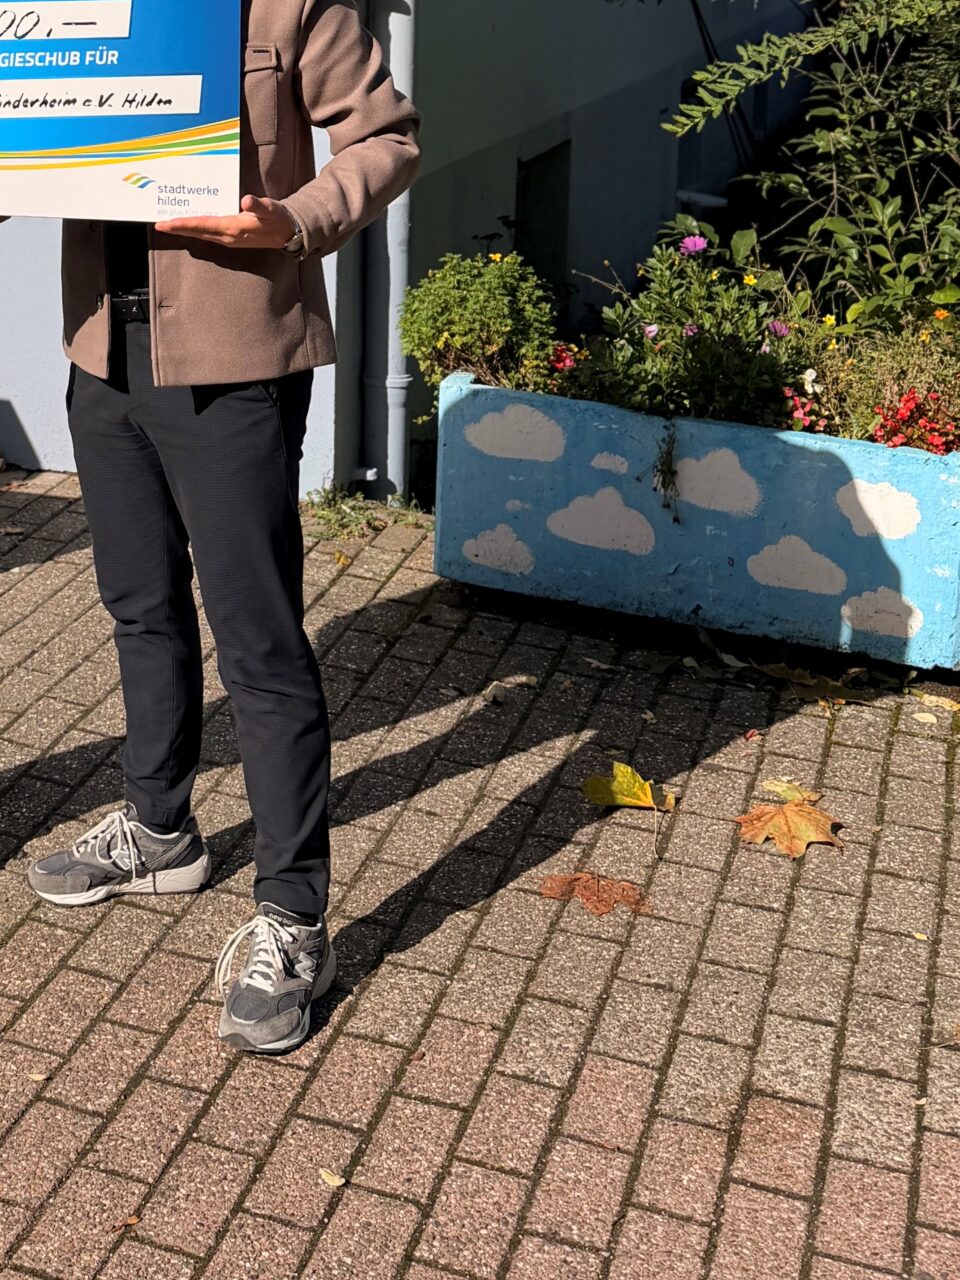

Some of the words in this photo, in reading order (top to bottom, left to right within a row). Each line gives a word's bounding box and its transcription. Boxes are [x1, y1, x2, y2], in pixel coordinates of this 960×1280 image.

[85, 46, 119, 66] FÜR
[122, 90, 173, 110] Hilden
[157, 184, 219, 196] stadtwerke
[157, 195, 190, 207] hilden
